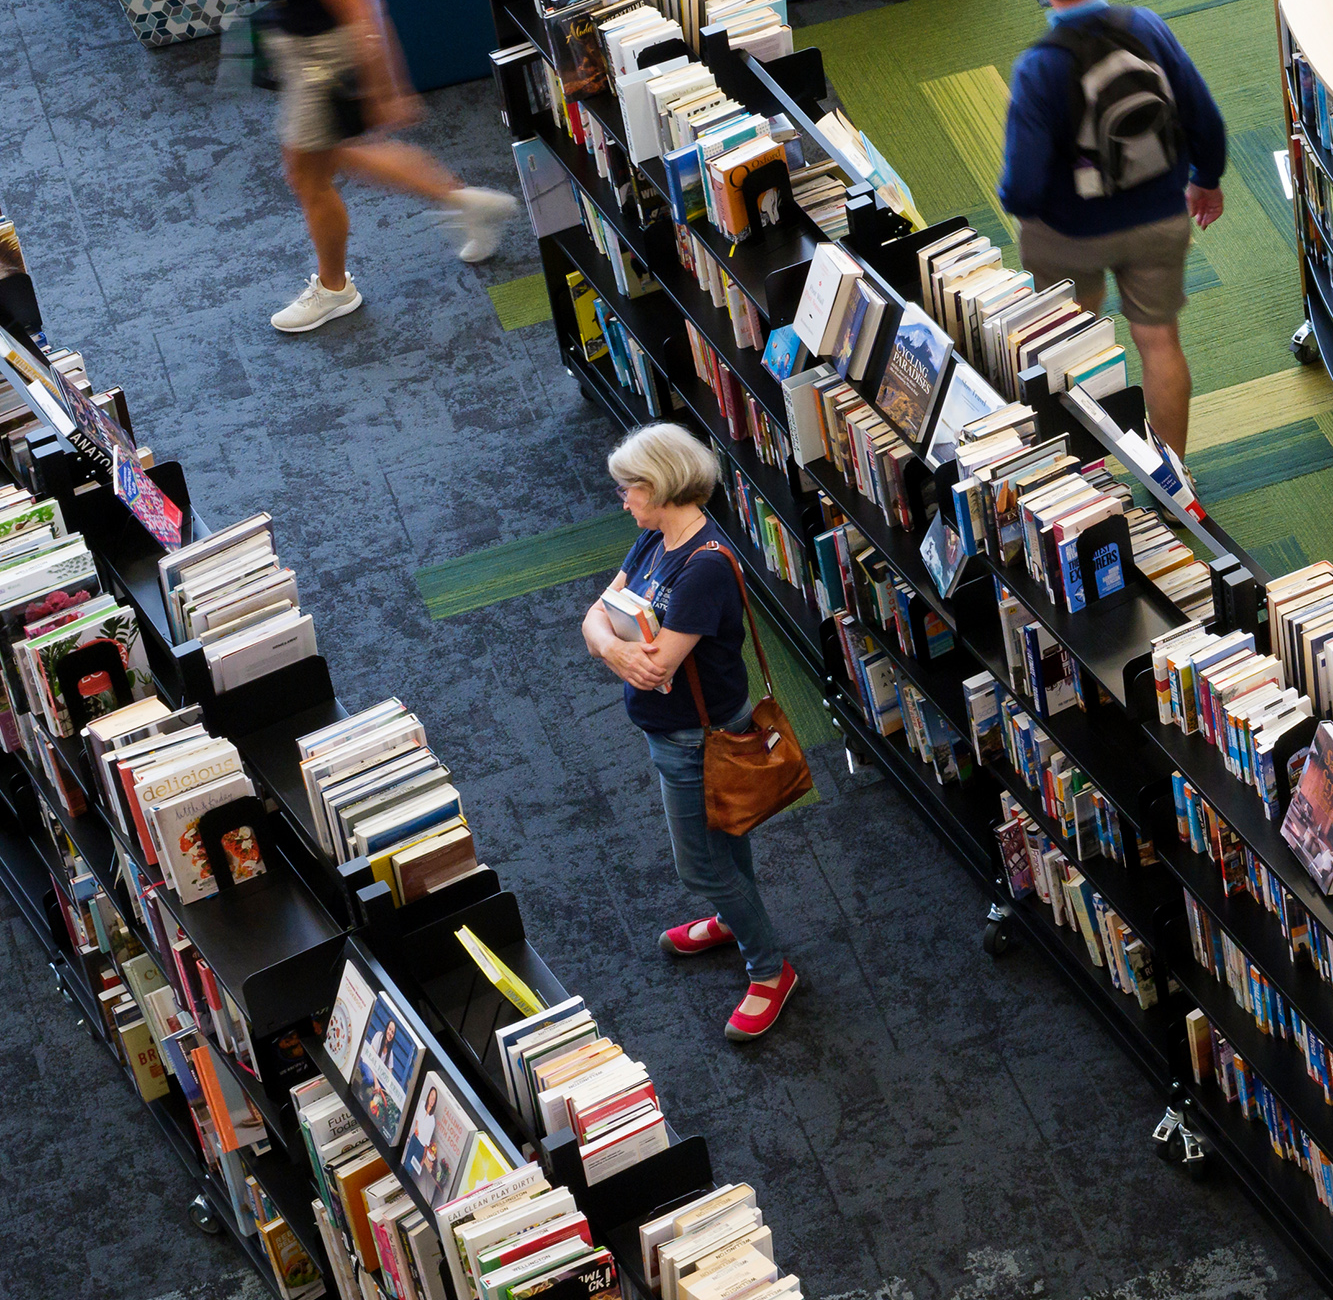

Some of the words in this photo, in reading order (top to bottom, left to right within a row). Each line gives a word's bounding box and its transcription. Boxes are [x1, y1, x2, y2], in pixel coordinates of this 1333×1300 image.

[565, 20, 594, 45] Aladd
[751, 148, 781, 169] Oxford
[892, 353, 932, 396] PARADISES
[894, 341, 930, 379] CYCLING
[363, 1047, 379, 1069] REAL
[377, 1061, 391, 1085] FOOD
[441, 1115, 449, 1128] IN
[447, 1123, 460, 1144] LOVE
[443, 1106, 463, 1137] FALLING
[436, 1118, 449, 1138] WITH
[448, 1136, 460, 1157] FOOD
[447, 1211, 462, 1223] EAT
[464, 1197, 489, 1214] CLEAN
[490, 1187, 511, 1203] PLAY
[513, 1175, 536, 1192] DIRTY
[490, 1190, 528, 1210] WELLINGTON
[512, 1254, 551, 1272] WELLINGTON
